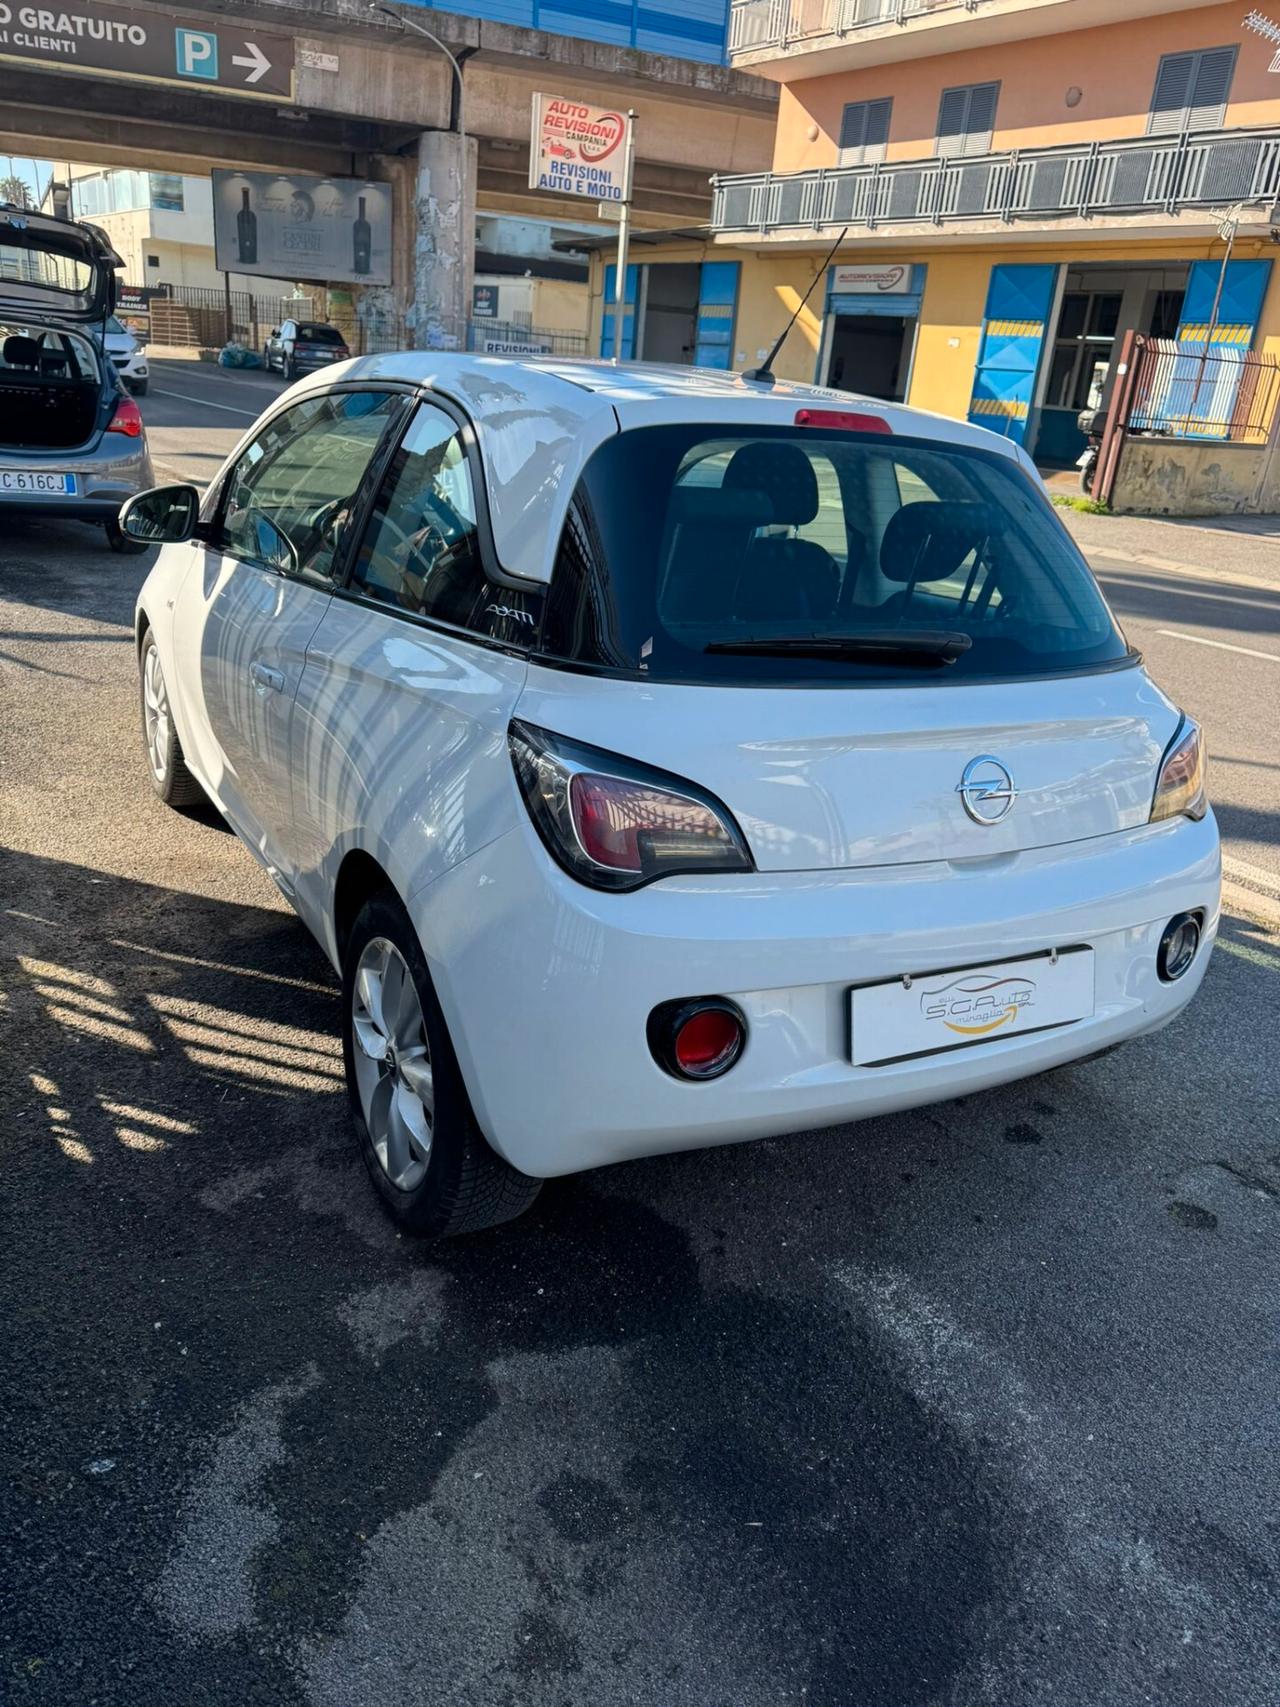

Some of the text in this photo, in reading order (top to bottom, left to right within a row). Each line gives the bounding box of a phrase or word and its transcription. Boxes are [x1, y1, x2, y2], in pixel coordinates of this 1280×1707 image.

[19, 7, 147, 46] GRATUITO
[13, 32, 77, 54] CLIENTI
[183, 33, 212, 72] P
[548, 100, 589, 119] AUTO
[543, 114, 617, 140] REVISIONI
[565, 131, 608, 147] CAMPANIA
[550, 160, 612, 184] REVISIONI
[539, 173, 621, 200] AUTO E MOTO
